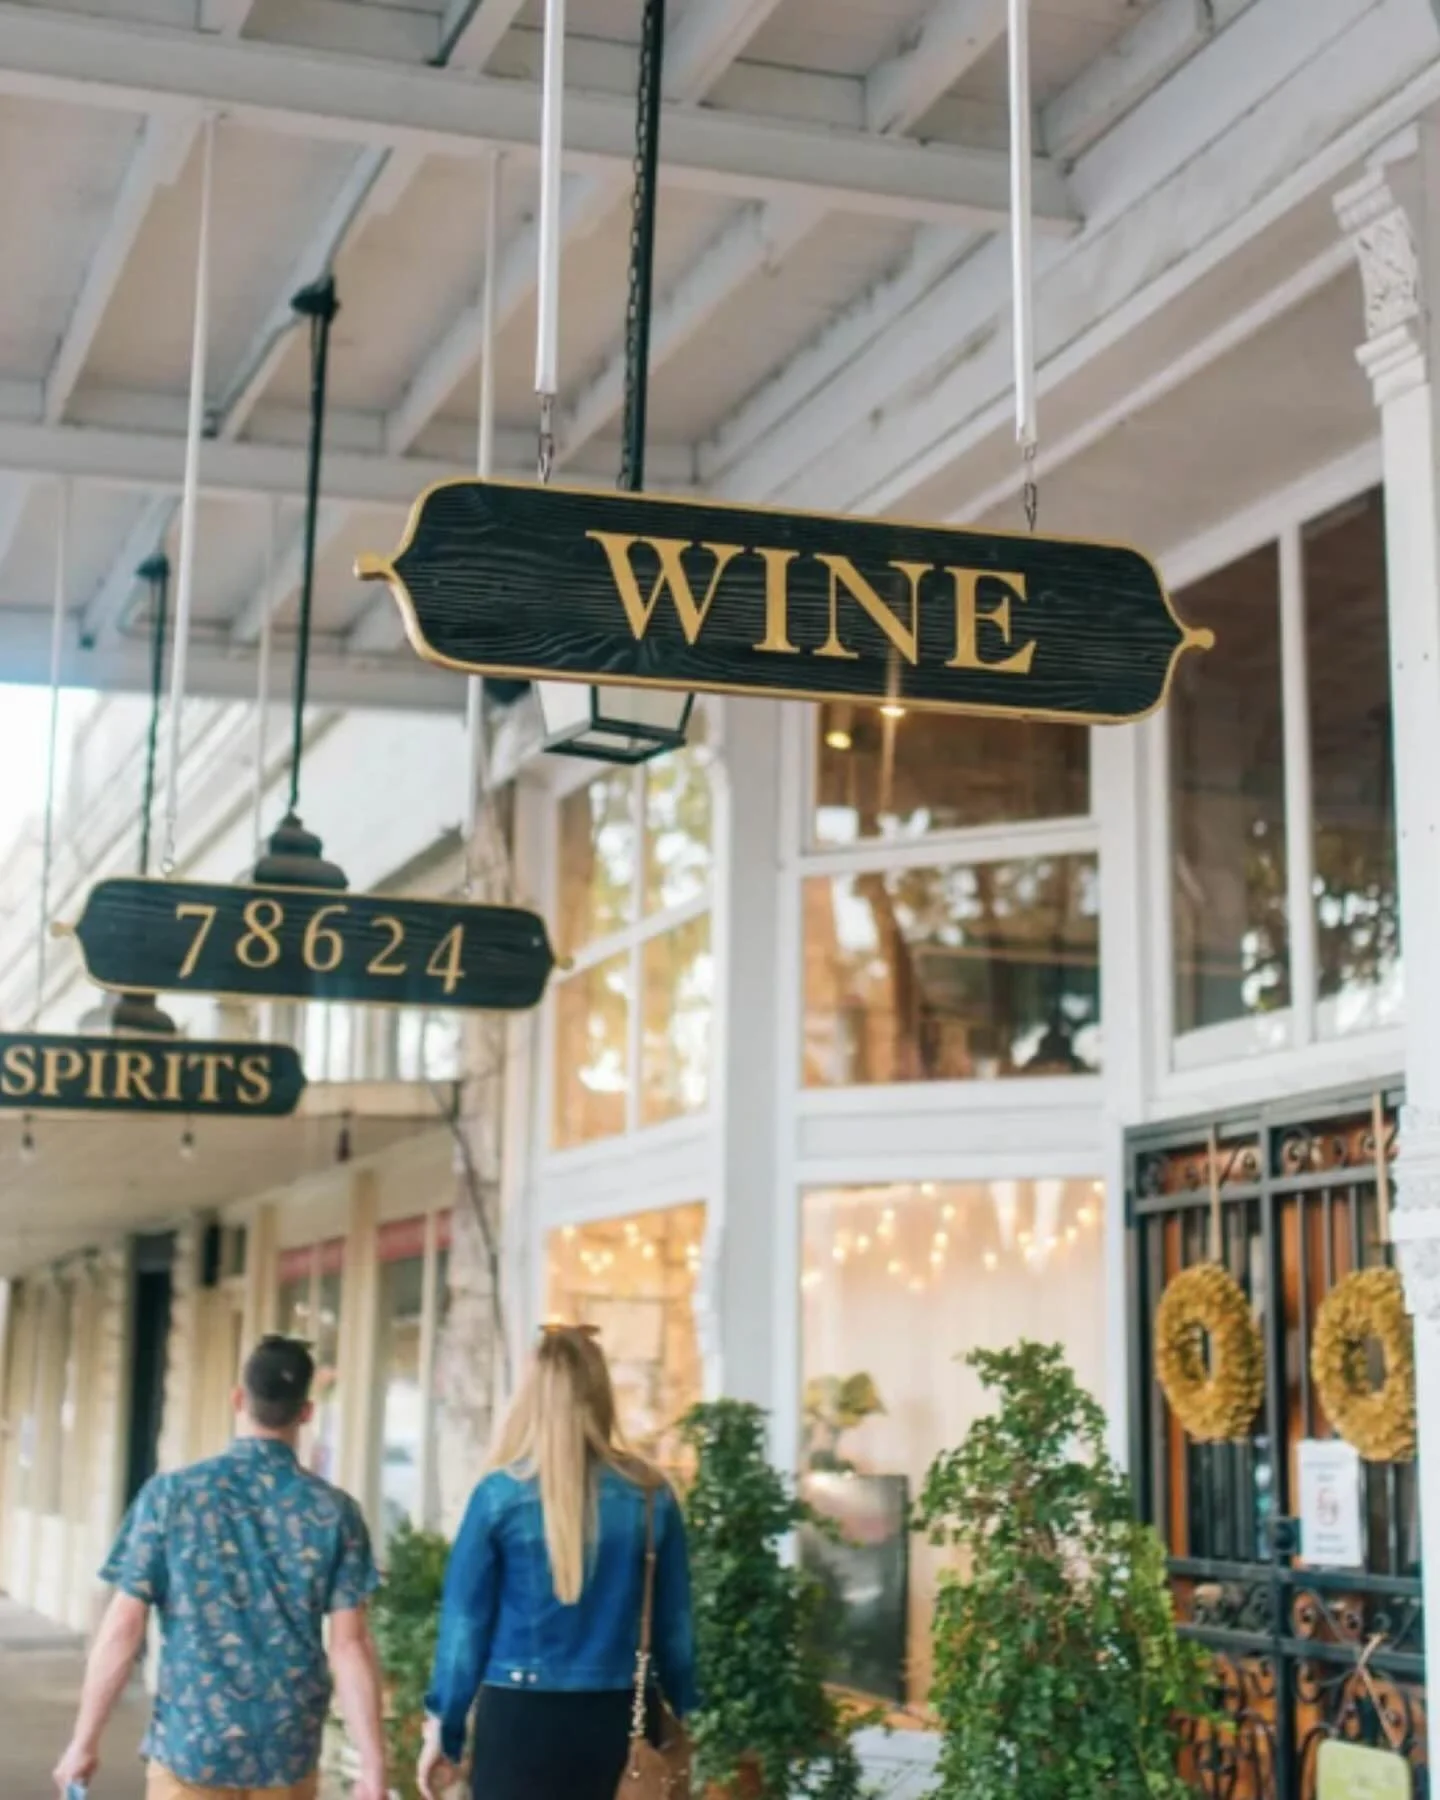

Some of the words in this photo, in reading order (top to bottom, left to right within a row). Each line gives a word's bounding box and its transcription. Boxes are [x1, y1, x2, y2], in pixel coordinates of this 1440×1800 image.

[585, 530, 1037, 674] WINE
[175, 900, 466, 994] 78624
[1, 1045, 273, 1104] SPIRITS
